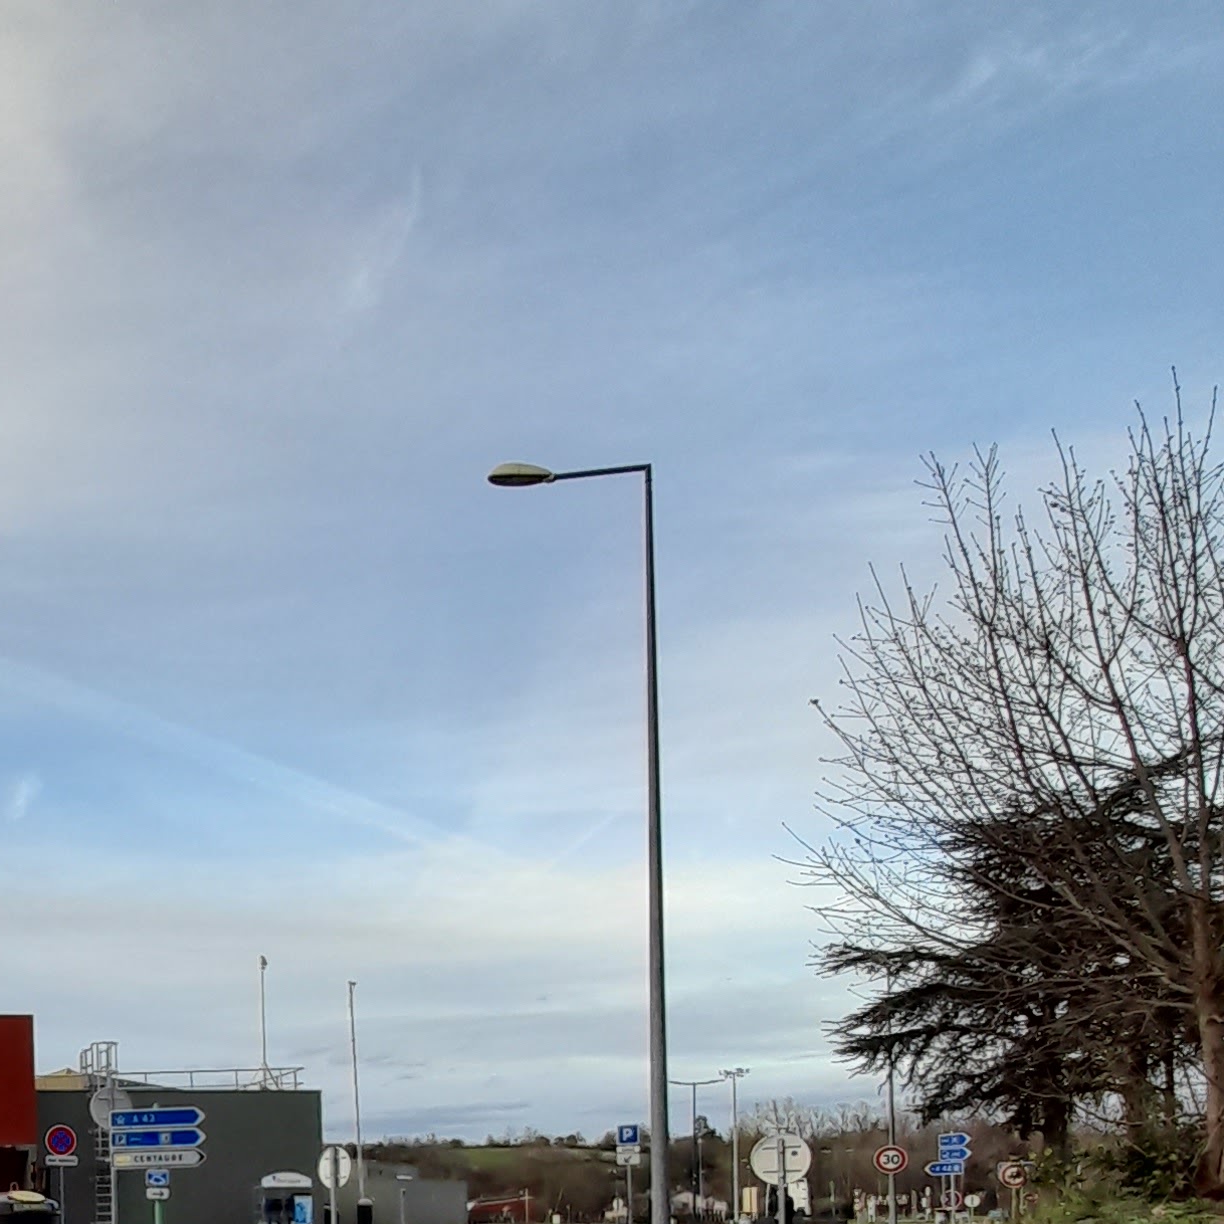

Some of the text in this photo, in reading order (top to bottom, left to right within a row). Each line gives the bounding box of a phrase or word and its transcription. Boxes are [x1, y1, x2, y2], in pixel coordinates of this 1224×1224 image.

[132, 1114, 139, 1123] A
[622, 1128, 633, 1141] P
[883, 1154, 900, 1165] 30
